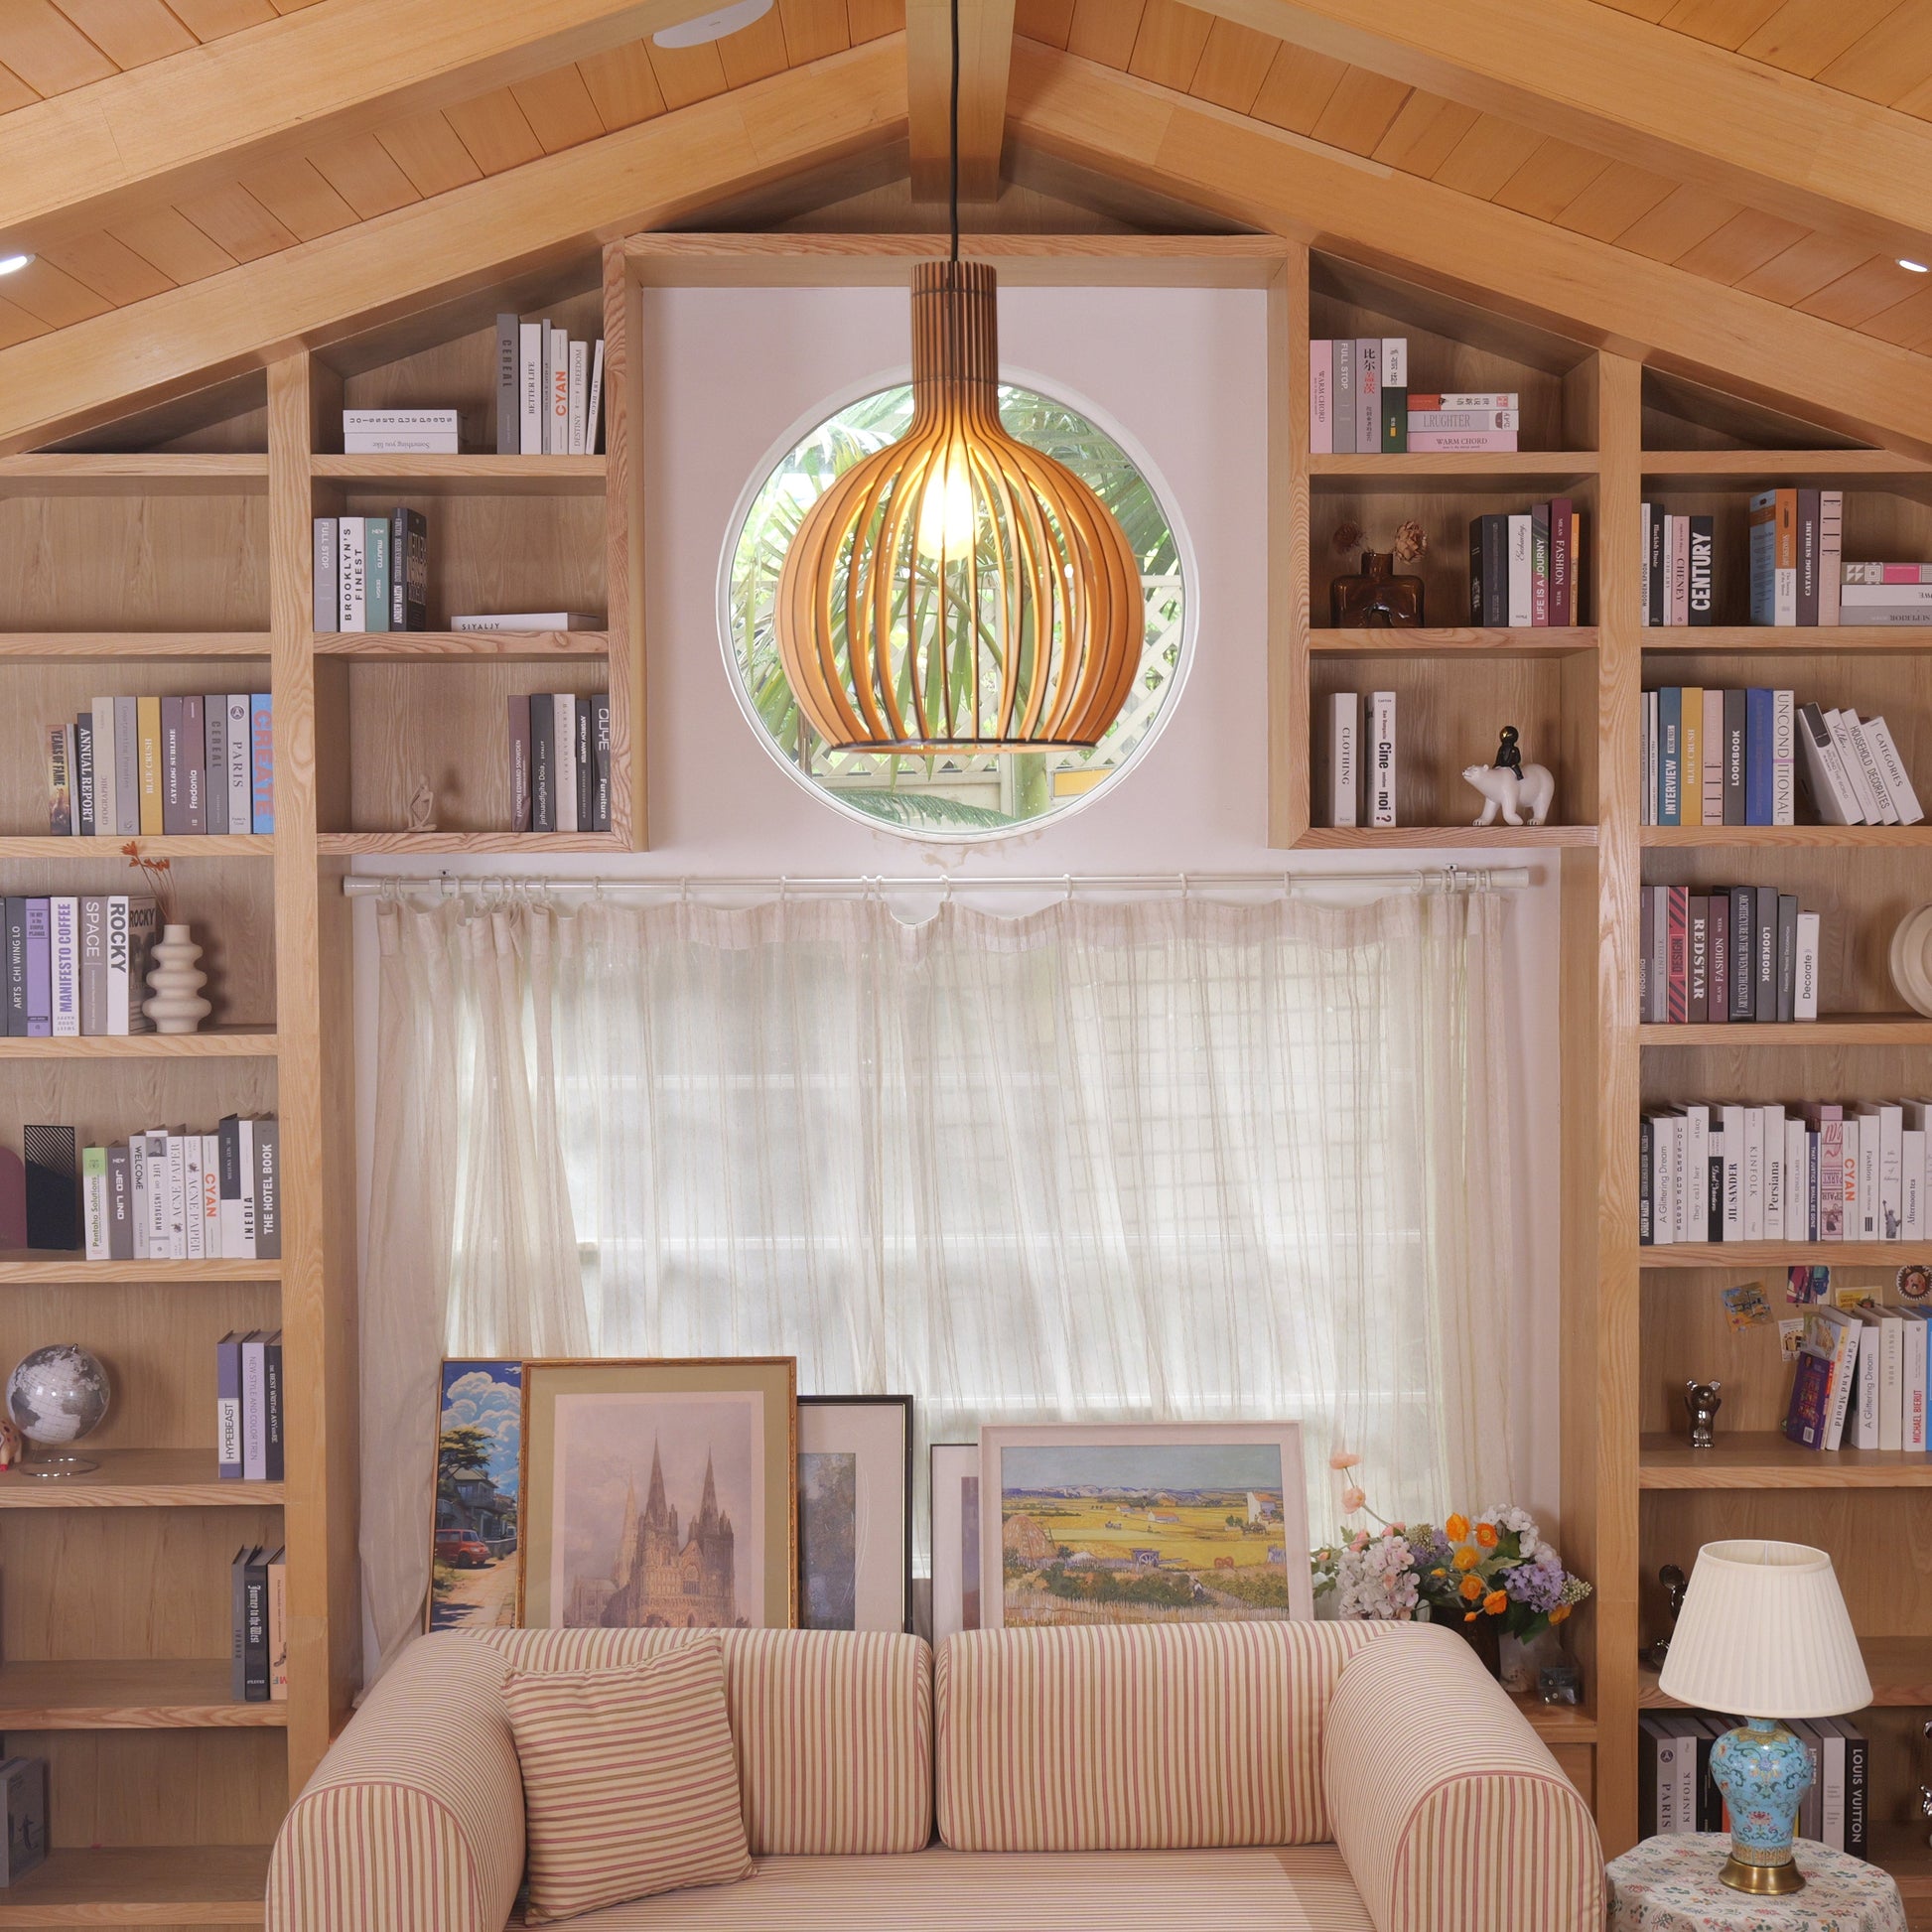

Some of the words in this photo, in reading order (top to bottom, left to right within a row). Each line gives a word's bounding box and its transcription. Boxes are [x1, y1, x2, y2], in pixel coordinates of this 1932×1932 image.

[556, 371, 566, 416] CYAN
[1676, 558, 1685, 602] CHENEY
[1692, 532, 1711, 611] CENTURY
[51, 730, 64, 754] YEARS
[80, 729, 92, 774] ANNUAL
[253, 710, 272, 816] CREATE
[1341, 728, 1350, 785] CLOTHING
[1379, 743, 1391, 768] Cine
[1875, 734, 1903, 787] CATEGORIES
[53, 765, 66, 785] FAME
[233, 742, 243, 787] PARIS
[1850, 725, 1871, 767] HOUSEHOLD
[1867, 767, 1889, 810] DECORATES
[81, 777, 93, 822] REPORT
[1379, 791, 1390, 810] noi
[1666, 759, 1676, 814] INTERVIEW
[12, 926, 20, 937] LO
[58, 903, 70, 944] COFFEE
[86, 901, 99, 957] SPACE
[111, 903, 126, 973] ROCKY
[130, 908, 155, 927] ROCKY
[12, 940, 21, 964] WING
[1672, 938, 1683, 973] DESIGN
[1694, 918, 1705, 999] REDSTAR
[59, 947, 71, 1012] MANIFESTO
[1803, 955, 1812, 999] Decorate
[171, 1144, 181, 1182] PAPER
[262, 1144, 271, 1173] BOOK
[206, 1173, 216, 1217] CYAN
[263, 1176, 272, 1206] HOTEL
[1659, 1175, 1669, 1213] Glittering
[1728, 1164, 1737, 1202] SANDER
[1768, 1162, 1779, 1211] Persiana
[1845, 1159, 1856, 1201] CYAN
[190, 1214, 200, 1252] PAPER
[244, 1196, 253, 1240] INEDIA
[263, 1208, 273, 1234] THE
[1844, 1340, 1857, 1369] Carve
[1864, 1383, 1874, 1419] Glittering
[248, 1585, 260, 1608] Journey
[250, 1627, 261, 1642] West
[1853, 1749, 1863, 1785] LOUIS
[1662, 1784, 1671, 1828] PARIS
[1852, 1789, 1862, 1843] VUITTON
